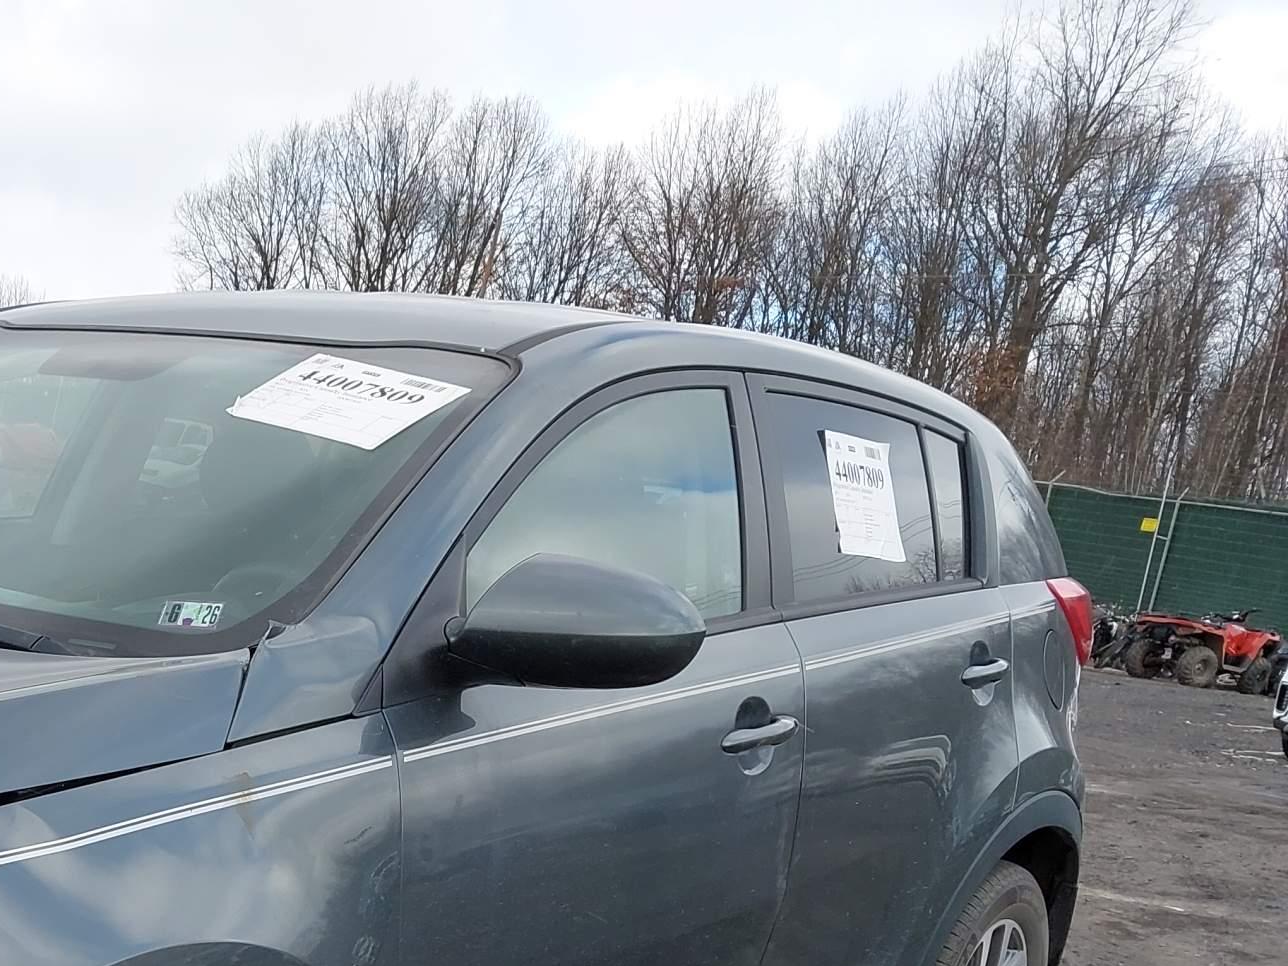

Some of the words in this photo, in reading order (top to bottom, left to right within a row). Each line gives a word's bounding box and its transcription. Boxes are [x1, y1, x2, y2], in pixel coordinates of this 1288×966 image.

[298, 370, 425, 405] 44007809
[835, 459, 884, 490] 44007809
[201, 605, 221, 625] 26
